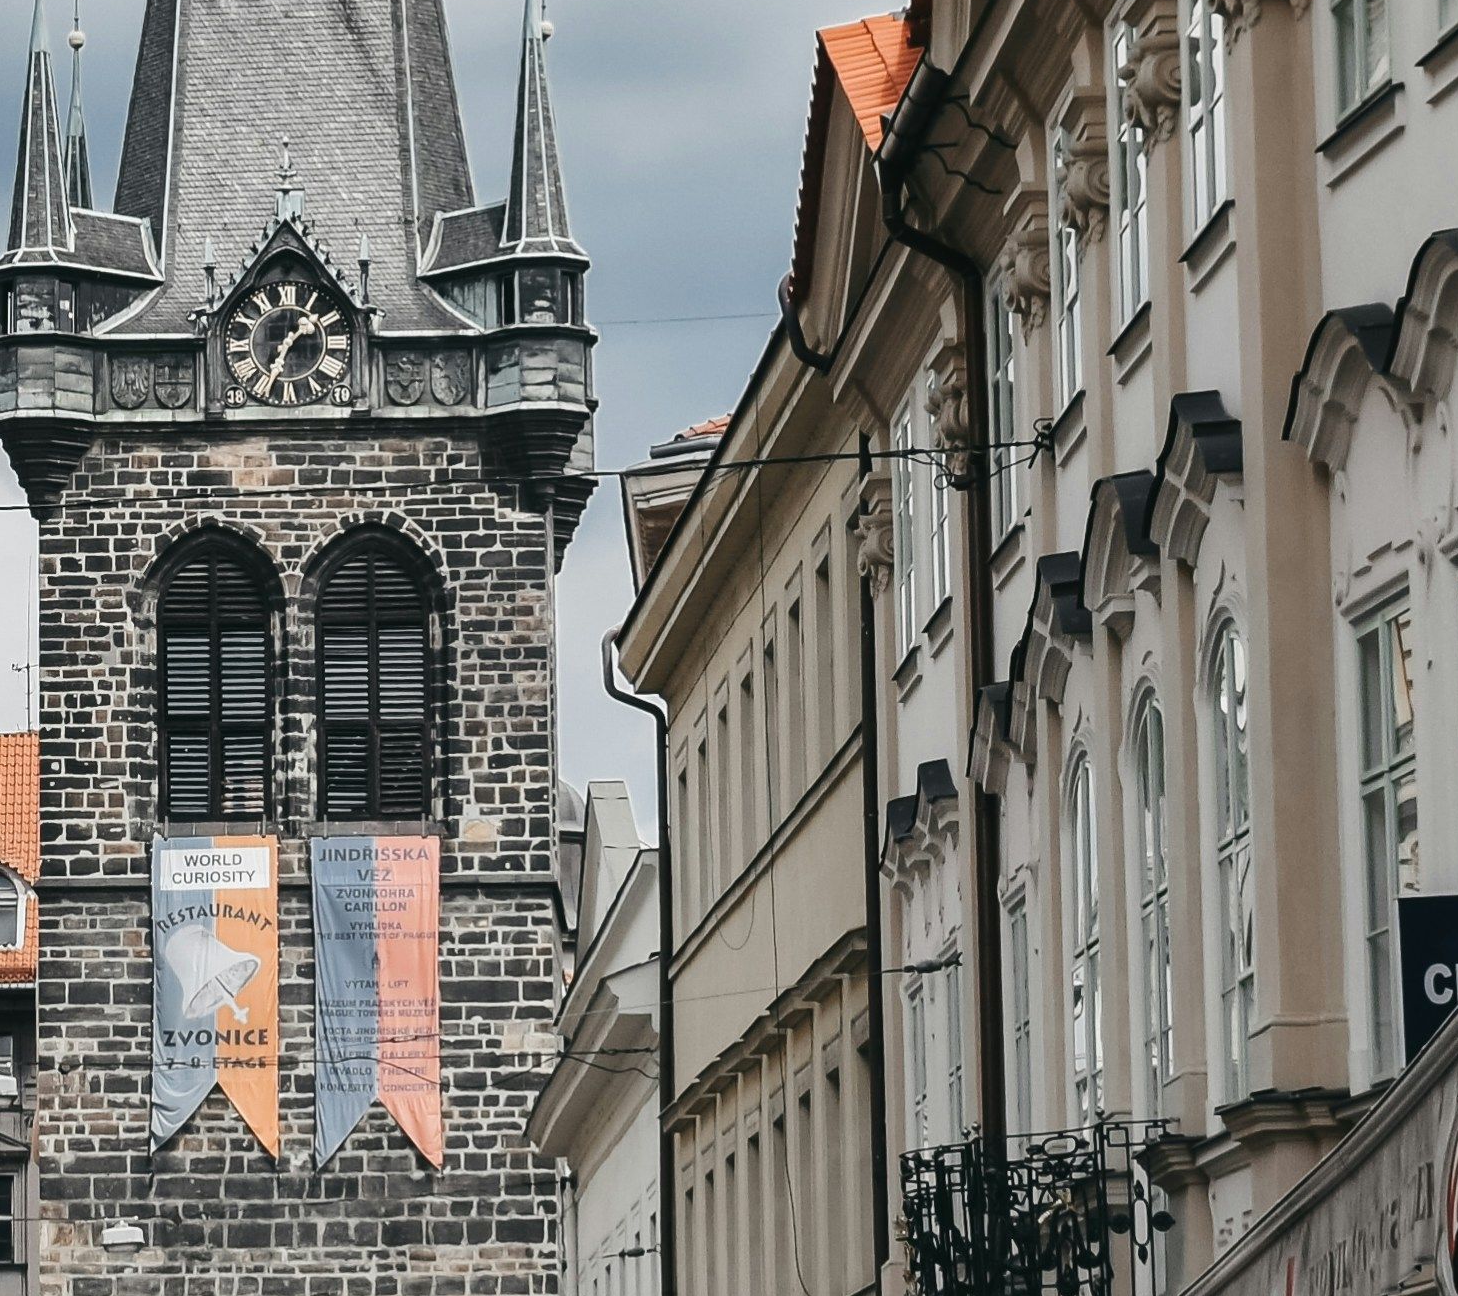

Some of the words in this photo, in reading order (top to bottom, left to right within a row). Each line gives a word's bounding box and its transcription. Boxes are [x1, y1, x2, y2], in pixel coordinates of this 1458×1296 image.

[184, 854, 243, 867] WORLD
[172, 870, 256, 885] CURIOSITY
[344, 902, 407, 913] CARILLON
[156, 903, 273, 934] RESTAURANT
[163, 1028, 269, 1047] ZVONICE
